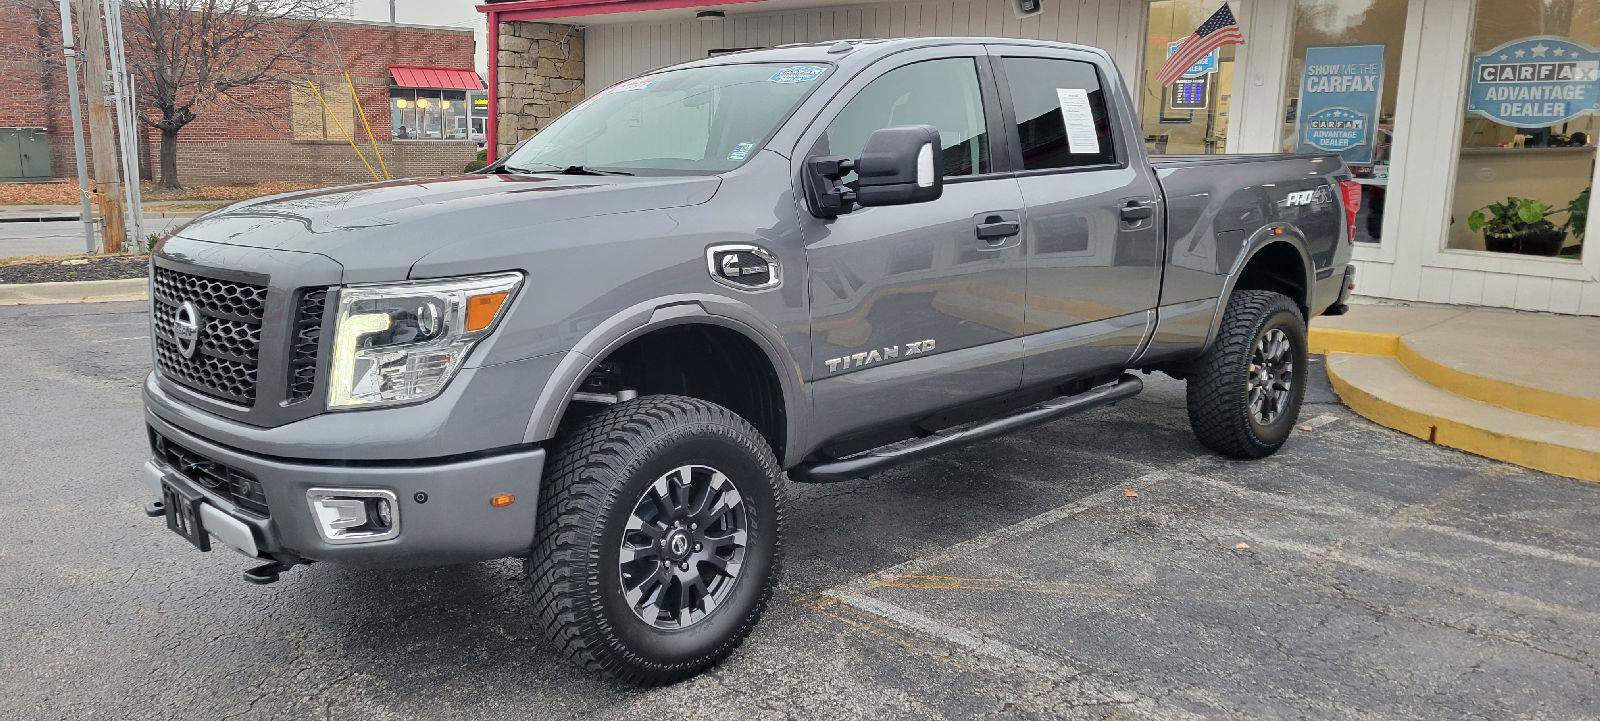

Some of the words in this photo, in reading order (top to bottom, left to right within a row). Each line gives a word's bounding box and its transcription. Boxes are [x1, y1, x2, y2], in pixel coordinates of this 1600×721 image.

[1308, 64, 1340, 76] SHOW
[1343, 63, 1357, 75] ME
[1359, 63, 1377, 75] THE
[1482, 64, 1596, 81] CARFAX
[1307, 75, 1378, 93] CARFAX
[1485, 84, 1586, 101] ADVANTAGE
[1500, 102, 1567, 117] DEALER
[1313, 130, 1357, 139] ADVANTAGE
[1320, 138, 1349, 147] DEALER
[824, 345, 899, 374] TITAN
[904, 339, 936, 357] XD
